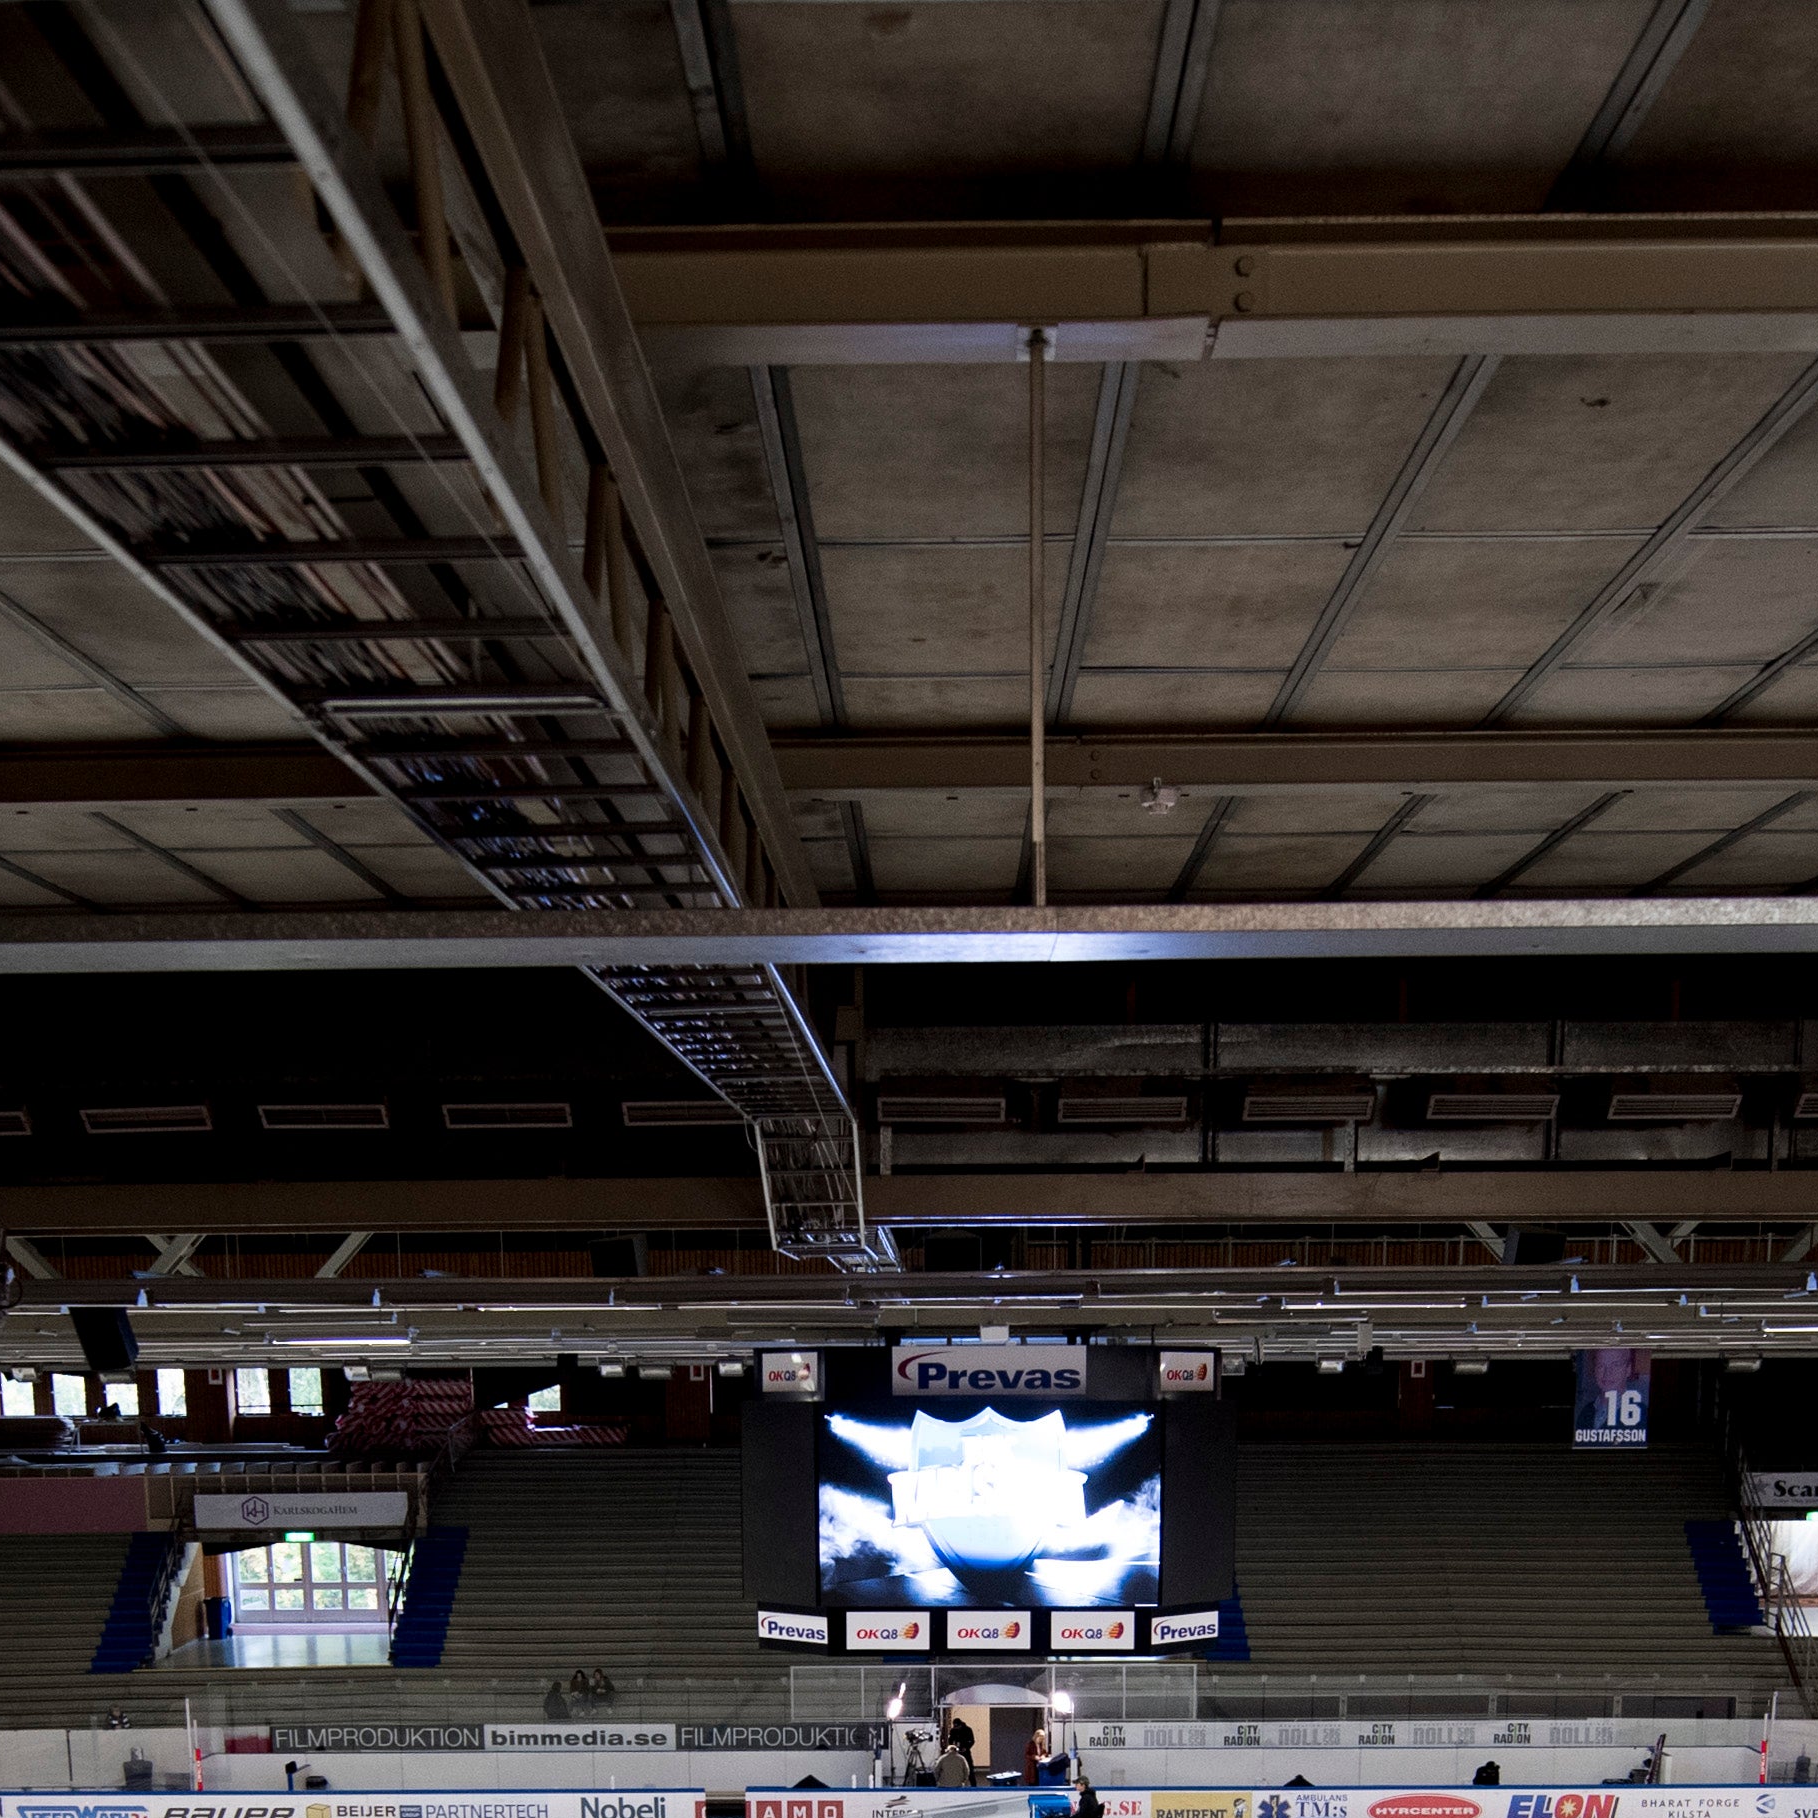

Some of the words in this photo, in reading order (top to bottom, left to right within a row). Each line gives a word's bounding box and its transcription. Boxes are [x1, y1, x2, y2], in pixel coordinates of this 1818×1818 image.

[918, 1361, 1081, 1391] Prevas
[1166, 1369, 1197, 1383] OKQ8
[1605, 1389, 1642, 1426] 16
[1575, 1428, 1646, 1443] GUSTAFSSON
[766, 1619, 827, 1643] Prevas
[856, 1628, 899, 1640] OKQ8
[957, 1628, 1000, 1640] OKQ8
[1060, 1628, 1104, 1640] OKQ8
[1157, 1617, 1217, 1641] Prevas
[275, 1726, 481, 1749] FILMPRODUKTION
[491, 1725, 668, 1748] bimmedia.se
[1296, 1794, 1349, 1802] AMBULANS
[1641, 1799, 1691, 1808] BHARAT
[1699, 1799, 1740, 1808] FORGE
[336, 1805, 397, 1818] BEIJER
[1295, 1801, 1348, 1818] TM:s
[1374, 1805, 1475, 1817] HYRCENTER
[1668, 1810, 1711, 1818] KILSTA
